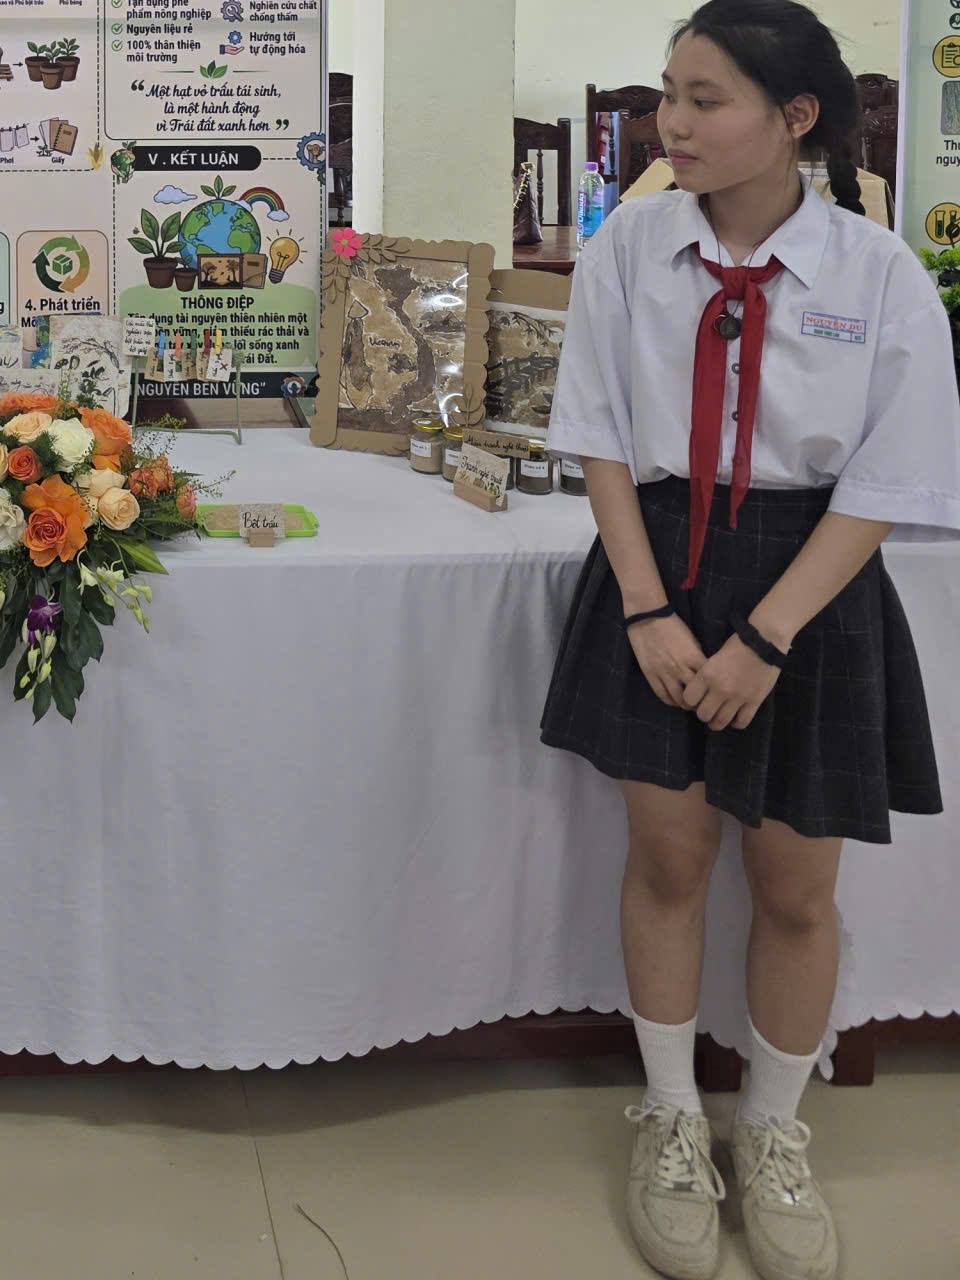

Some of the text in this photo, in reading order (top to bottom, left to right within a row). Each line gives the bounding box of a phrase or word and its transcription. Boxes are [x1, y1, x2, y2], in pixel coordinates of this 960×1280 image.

[164, 101, 260, 118] là một hành động
[157, 117, 270, 131] vì Trái đất xanh hơn
[171, 149, 197, 165] KẾT
[201, 153, 239, 167] LUẬN
[25, 296, 101, 311] 4. Phát triển
[181, 294, 254, 312] THÔNG ĐIỆP
